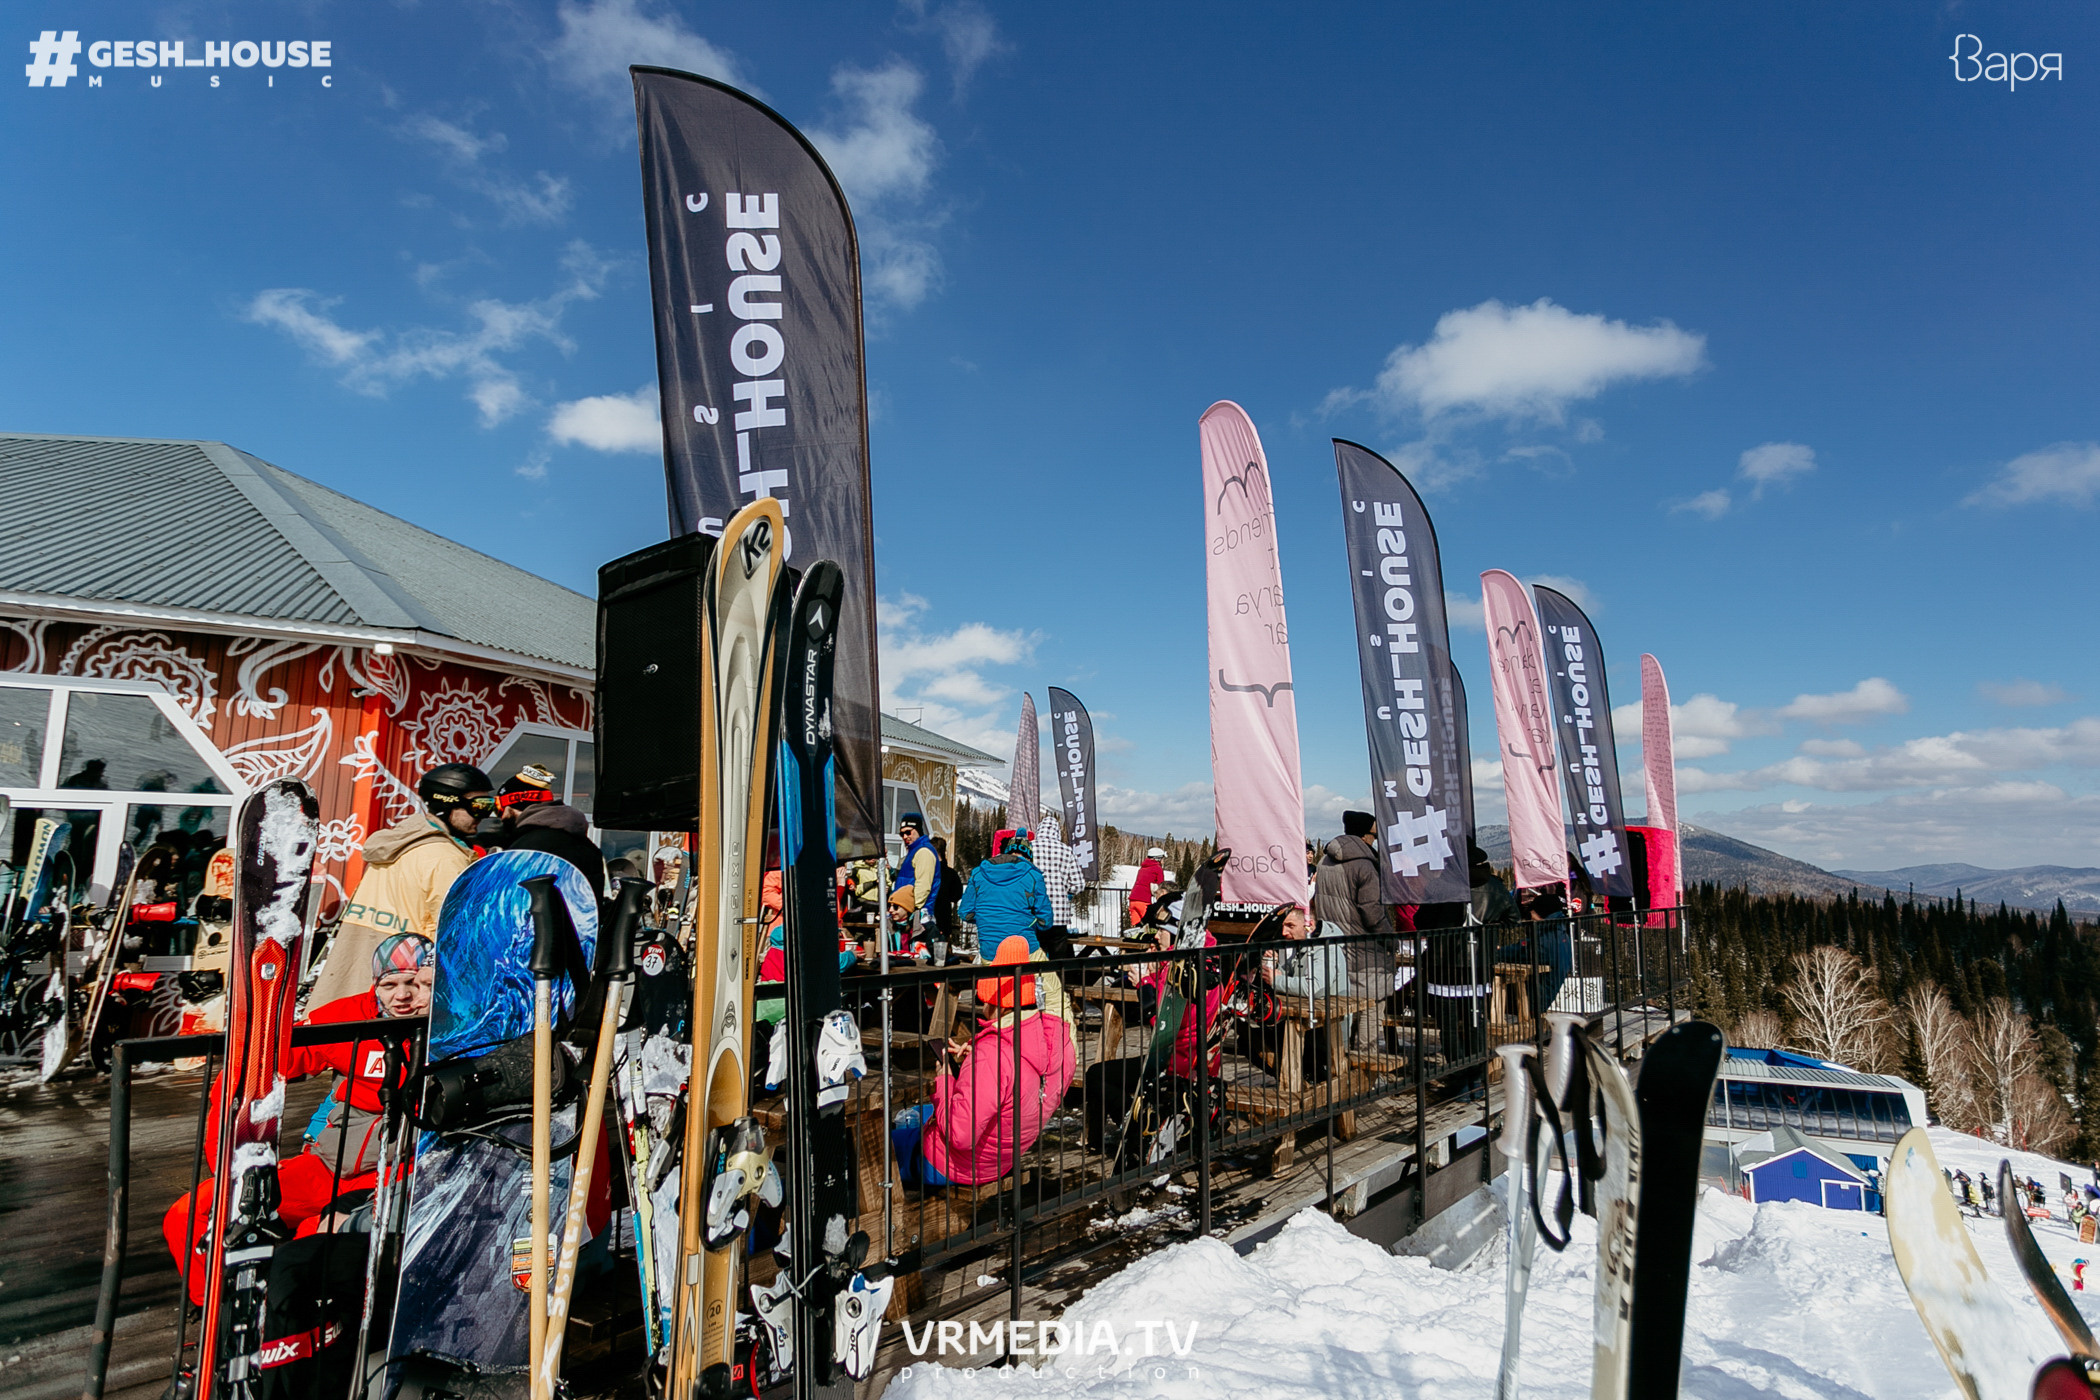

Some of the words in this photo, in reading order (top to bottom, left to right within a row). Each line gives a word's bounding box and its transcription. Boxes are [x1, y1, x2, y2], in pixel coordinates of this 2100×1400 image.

[740, 521, 772, 574] K2
[805, 649, 818, 746] DYNASTAR
[645, 955, 659, 969] 37
[709, 1304, 722, 1319] 20
[261, 1341, 300, 1364] wix
